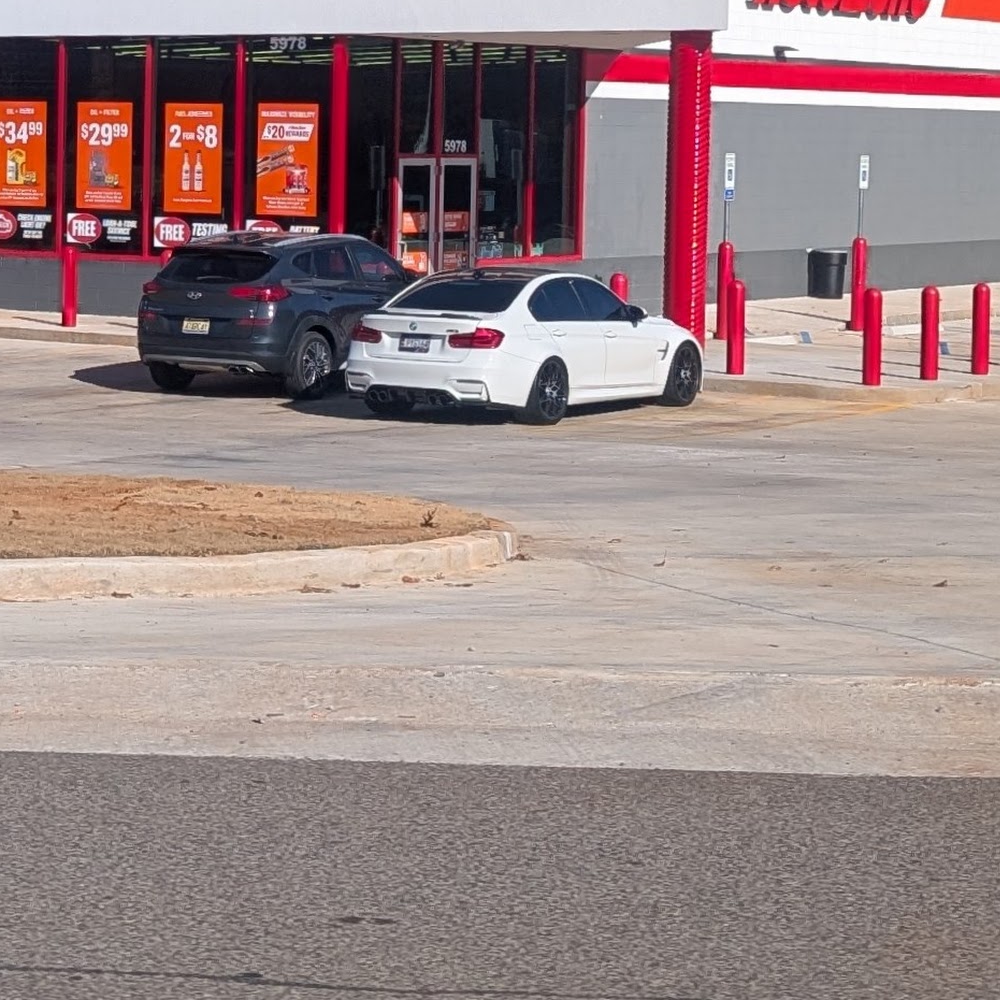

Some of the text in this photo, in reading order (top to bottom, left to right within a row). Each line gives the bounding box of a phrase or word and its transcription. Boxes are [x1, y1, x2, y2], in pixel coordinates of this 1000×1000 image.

[270, 36, 307, 50] 5978
[169, 124, 182, 148] 2
[196, 124, 218, 149] $8
[267, 125, 285, 139] $20
[444, 139, 467, 152] 5978
[72, 219, 97, 238] FREE
[159, 223, 185, 241] FREE
[191, 222, 228, 238] TESTING
